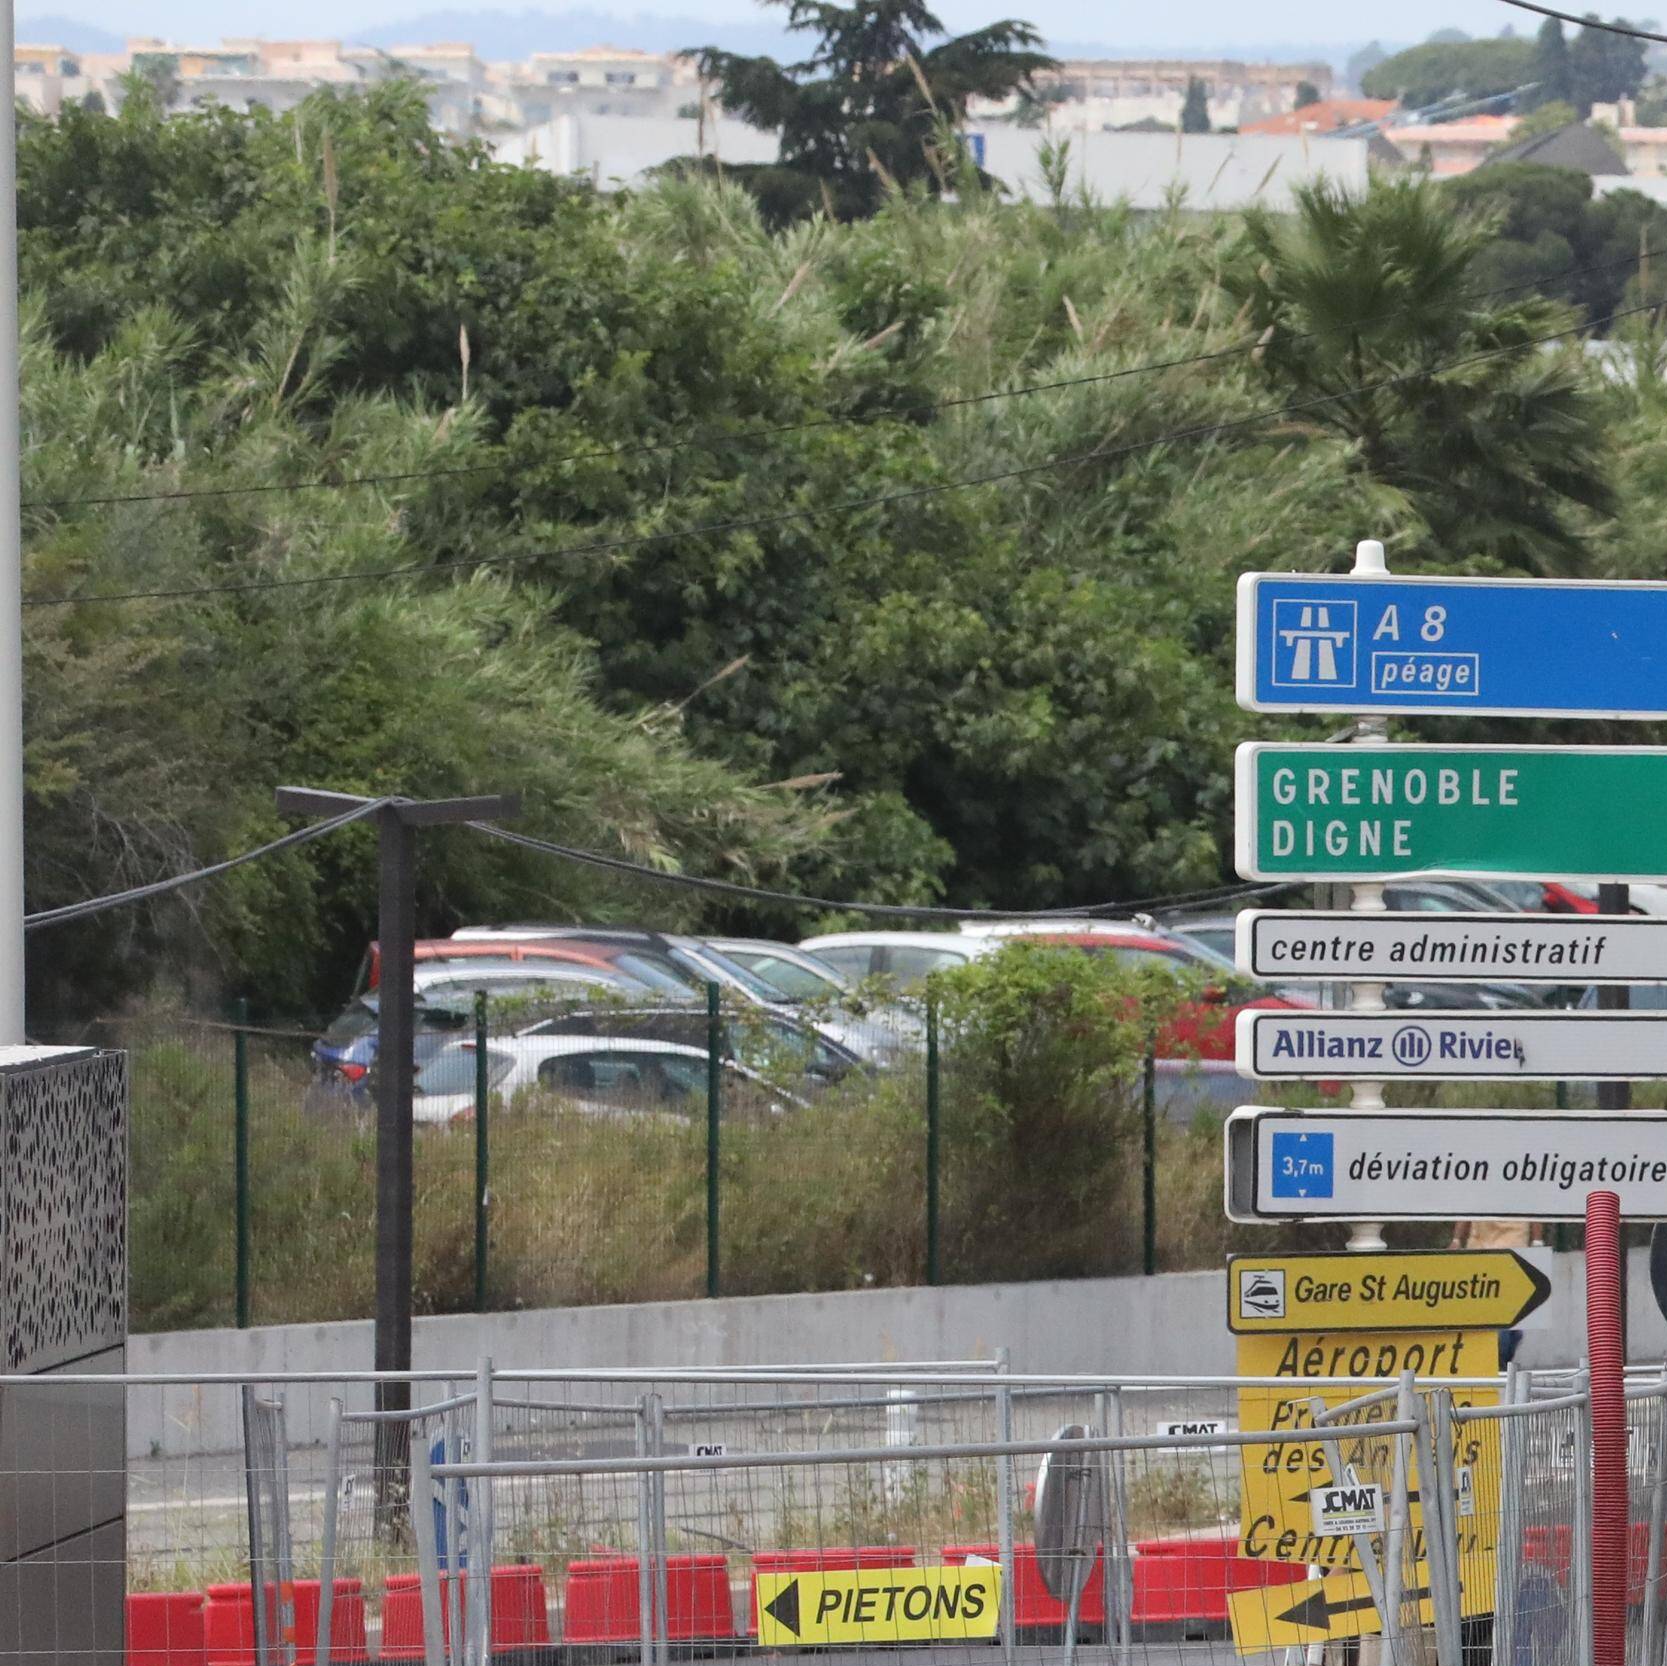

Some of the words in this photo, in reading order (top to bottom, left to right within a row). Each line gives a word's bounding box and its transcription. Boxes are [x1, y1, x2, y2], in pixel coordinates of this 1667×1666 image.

[1372, 604, 1401, 641] A
[1421, 605, 1447, 642] 8
[1381, 655, 1471, 691] péage
[1272, 767, 1519, 805] GRENOBLE
[1272, 819, 1412, 857] DIGNE
[1271, 936, 1375, 962] centre
[1389, 933, 1605, 966] administratif
[1272, 1029, 1383, 1059] Allianz
[1282, 1156, 1324, 1177] 3,7m
[1348, 1151, 1489, 1182] déviation
[1502, 1153, 1667, 1189] obligatoire
[1295, 1275, 1351, 1304] Gare
[1359, 1273, 1387, 1302] St
[1393, 1272, 1500, 1308] Augustin
[1275, 1331, 1465, 1378] Aéroport
[816, 1583, 985, 1625] PIETONS
